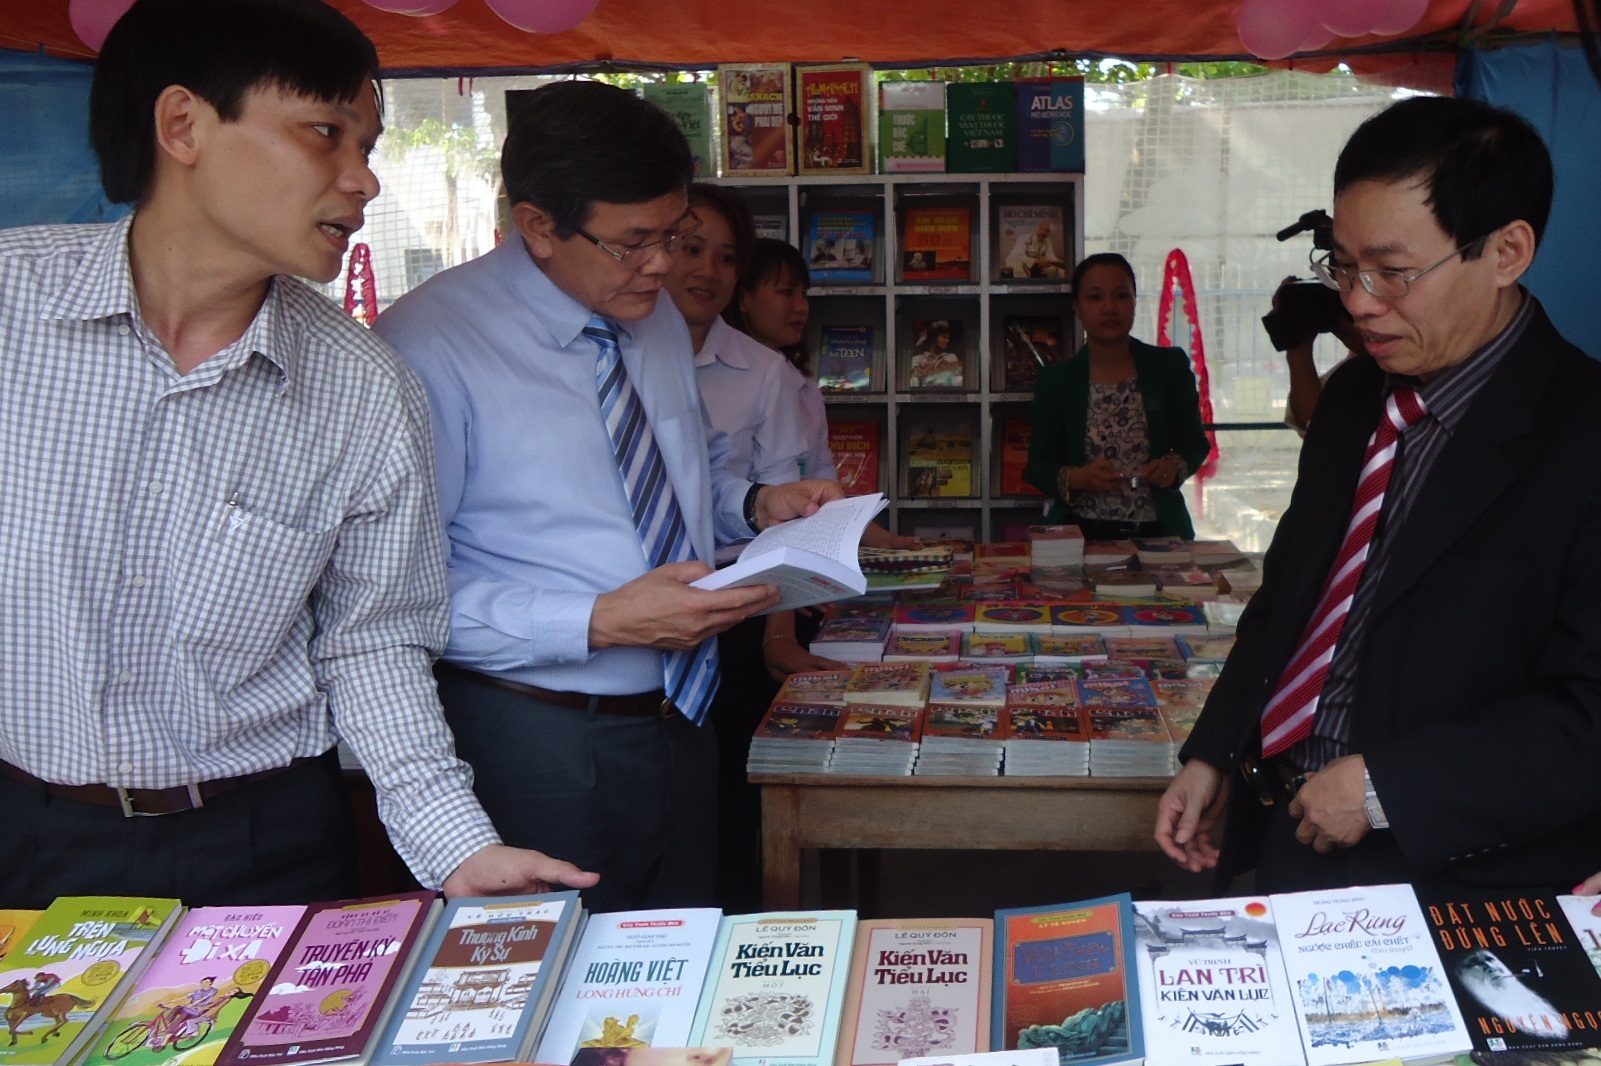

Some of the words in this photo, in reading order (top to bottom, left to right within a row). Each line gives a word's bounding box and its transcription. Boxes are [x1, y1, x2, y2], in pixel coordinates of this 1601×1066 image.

[1031, 95, 1073, 110] ATLAS
[1484, 898, 1551, 922] NƯỚC
[67, 920, 116, 939] TRÊN
[756, 925, 769, 933] LÊ
[1295, 912, 1346, 938] Lạc
[1342, 908, 1407, 936] Rừng
[459, 929, 508, 946] Thượng
[507, 925, 539, 942] Kinh
[1439, 926, 1507, 950] ĐỨNG
[1514, 922, 1564, 946] LÊN
[735, 941, 783, 960] Kiến
[785, 942, 824, 958] Văn
[878, 949, 926, 966] Kiến
[927, 949, 968, 965] Văn
[297, 965, 334, 987] TÂN
[583, 958, 643, 986] HOÀNG
[646, 956, 689, 985] VIỆT
[730, 958, 779, 979] Tiểu
[780, 960, 822, 980] Lục
[874, 966, 924, 985] Tiểu
[925, 967, 968, 987] Lục
[1159, 968, 1213, 986] LAN
[1218, 964, 1266, 984] TRÌ
[576, 988, 613, 999] LONG
[657, 984, 684, 997] CHÍ
